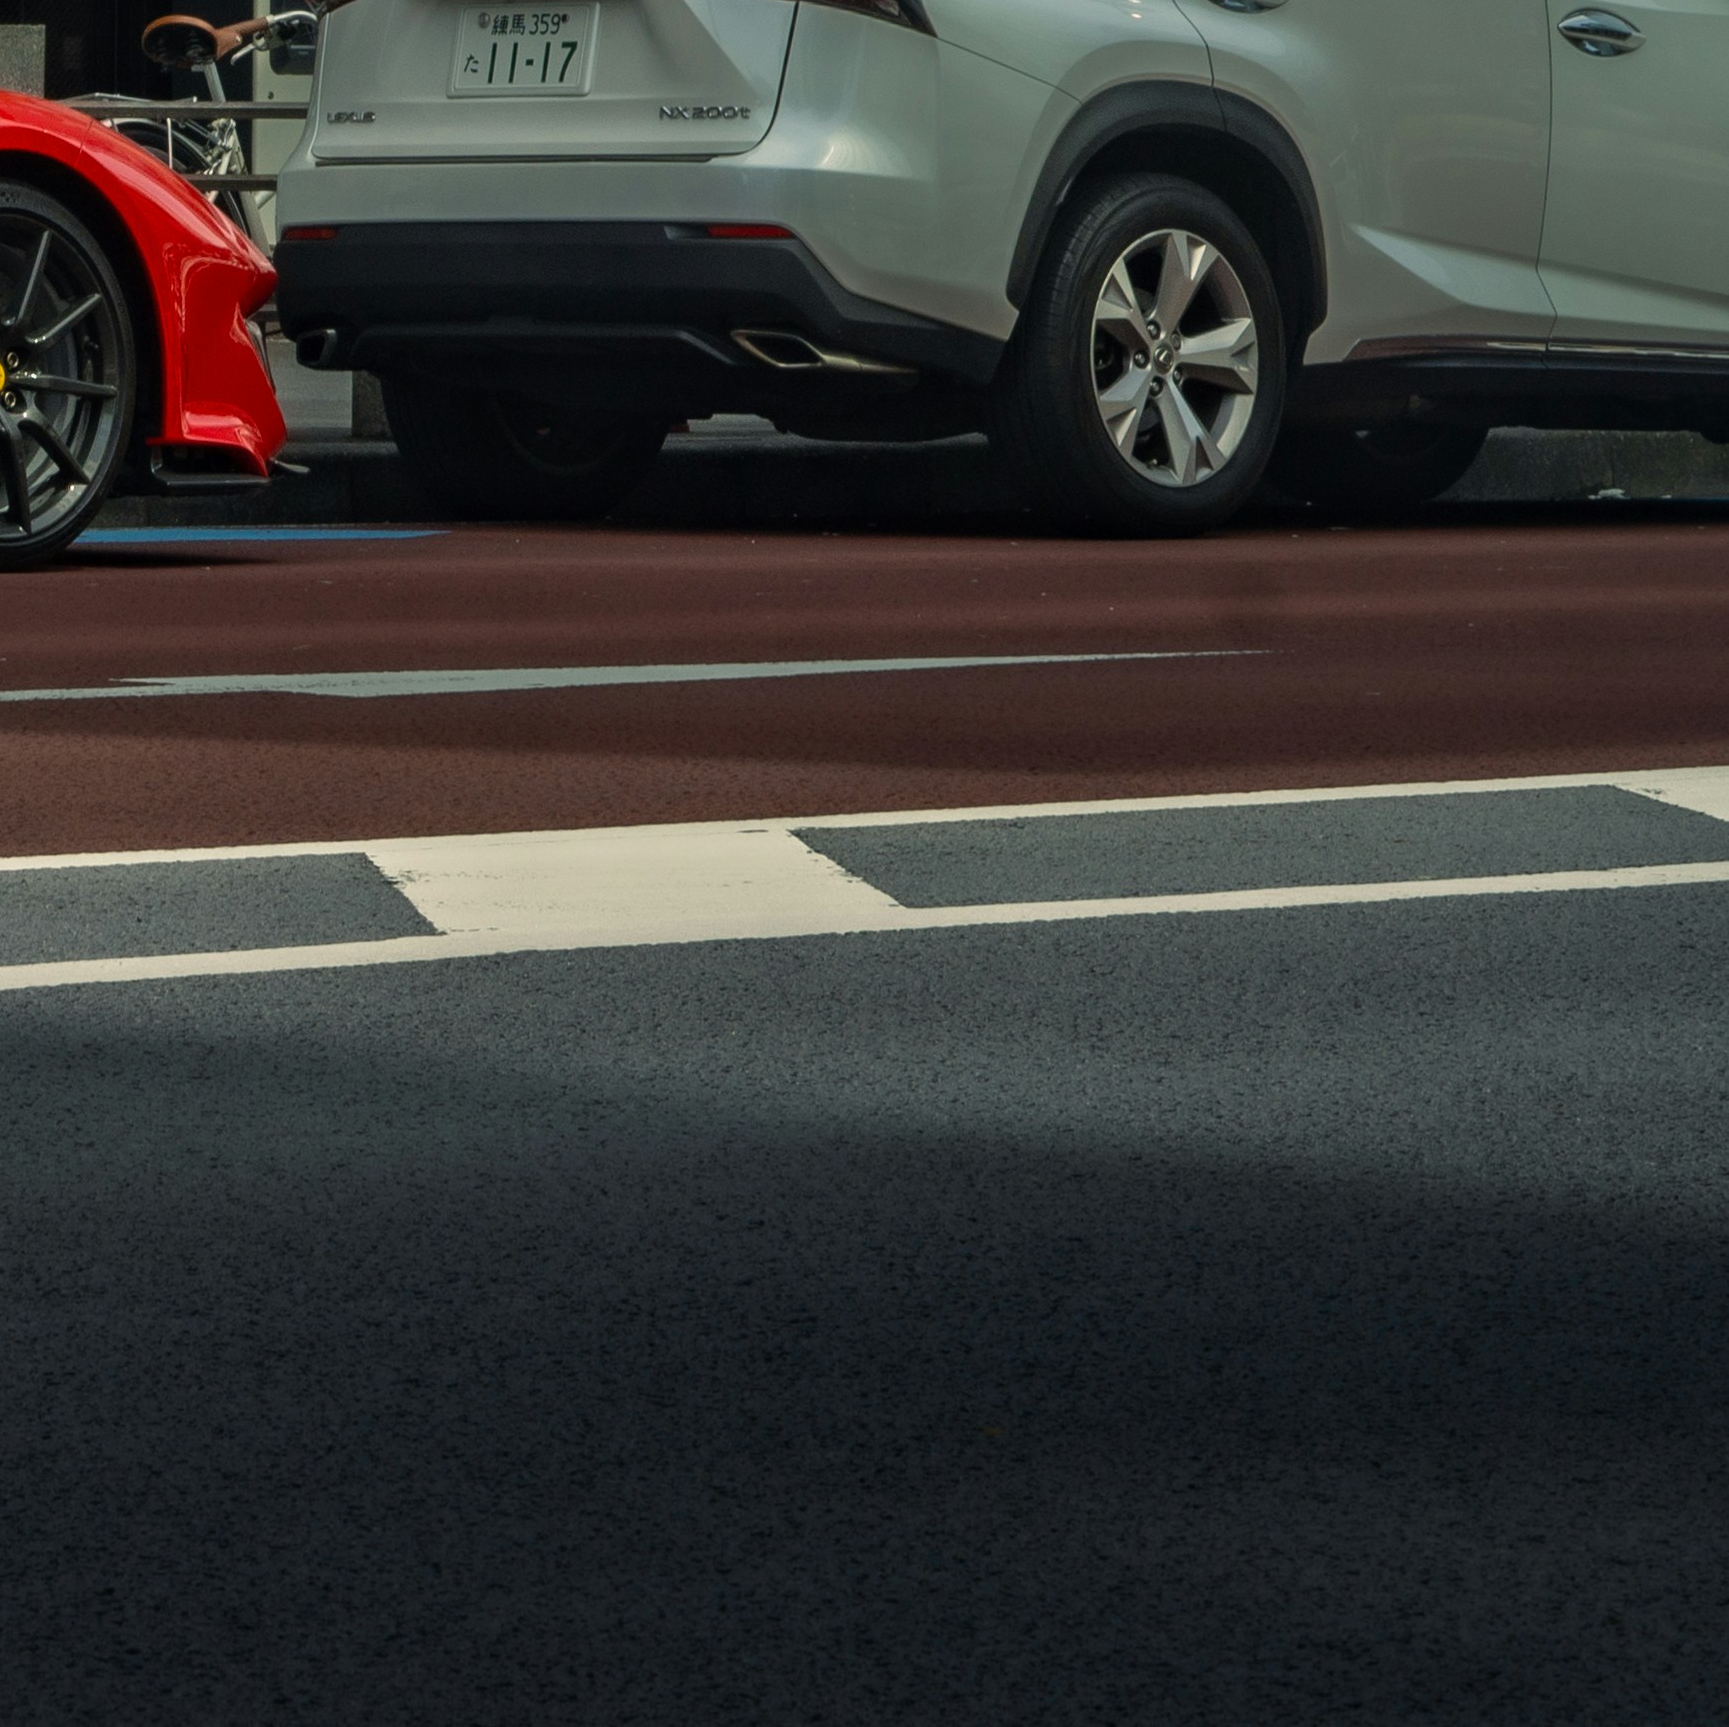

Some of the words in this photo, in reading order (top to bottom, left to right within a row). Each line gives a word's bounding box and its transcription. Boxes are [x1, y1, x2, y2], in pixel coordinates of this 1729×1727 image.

[491, 14, 526, 36] 練馬
[529, 13, 561, 35] 359
[464, 54, 479, 73] た
[487, 41, 578, 84] 11-17
[326, 112, 377, 124] LEXUS
[659, 106, 690, 120] NX
[692, 106, 751, 120] 200t
